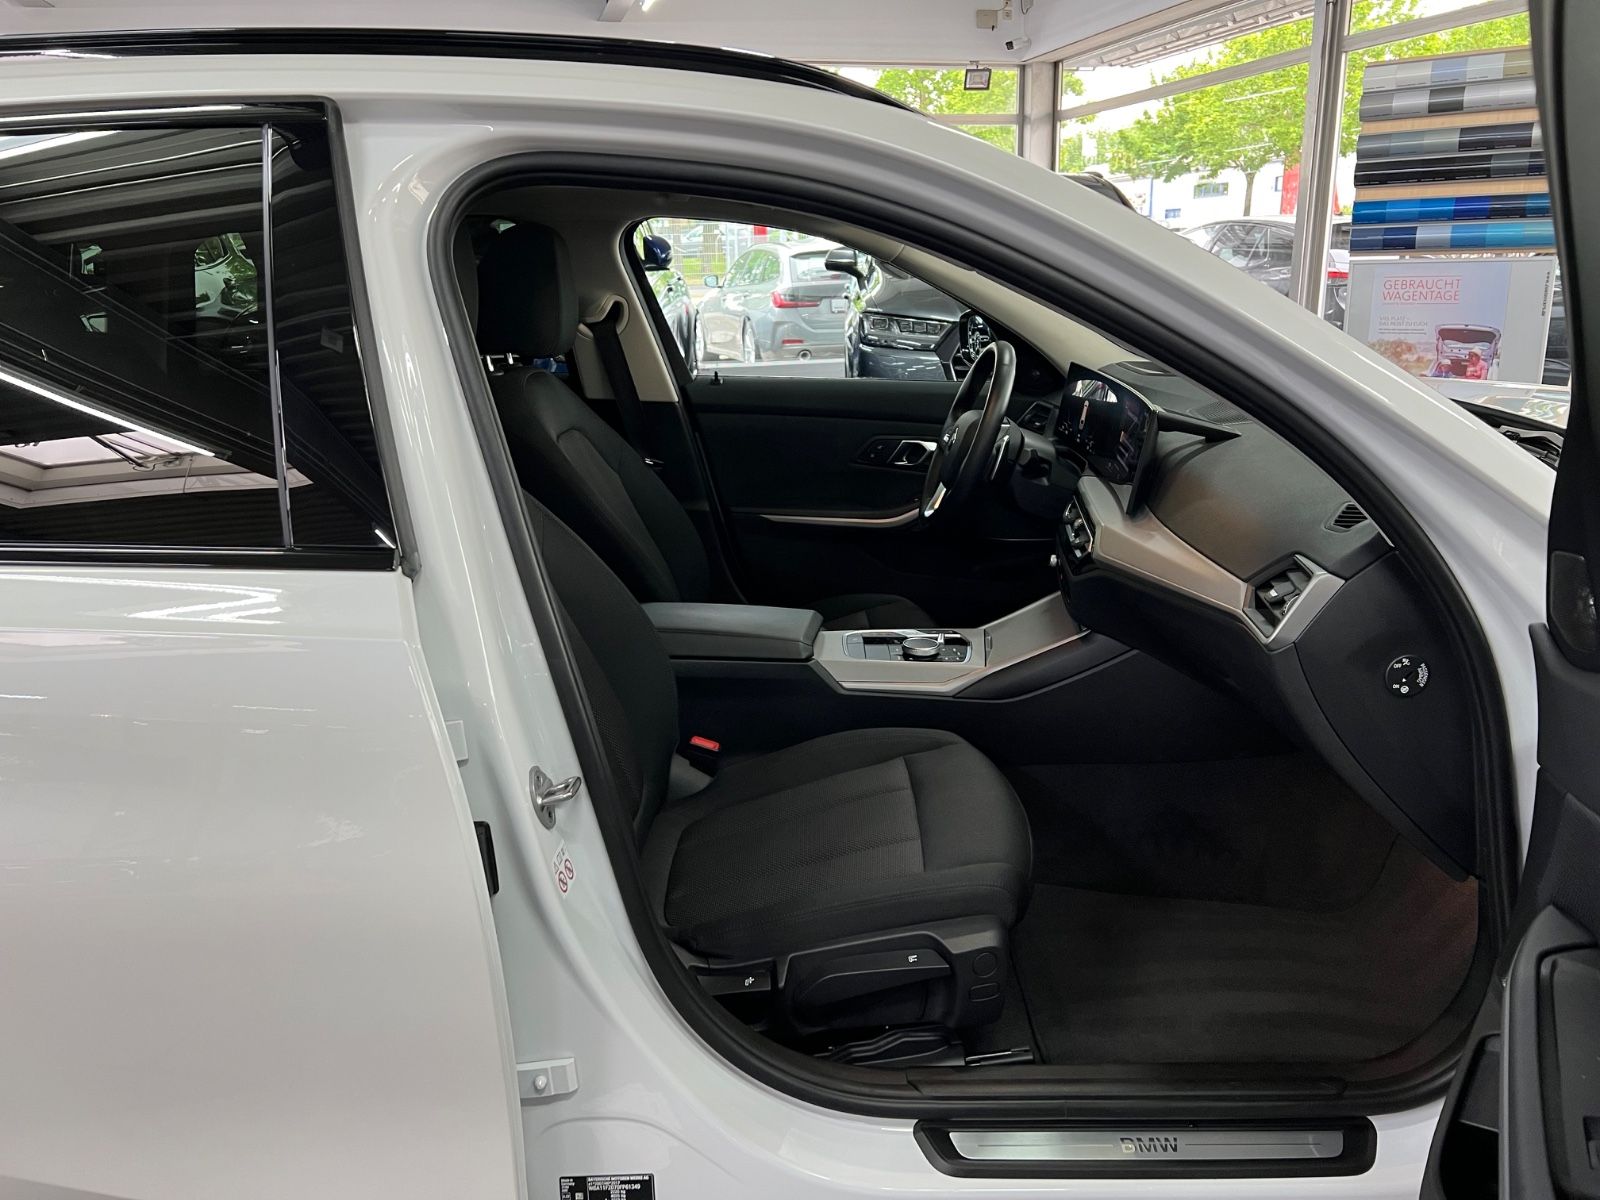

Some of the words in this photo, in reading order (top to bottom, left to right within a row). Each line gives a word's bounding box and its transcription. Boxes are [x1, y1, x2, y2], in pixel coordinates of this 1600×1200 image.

[1383, 279, 1462, 290] GEBRAUCHT
[1382, 290, 1460, 301] WAGENTAGE
[1120, 1137, 1178, 1152] BMW
